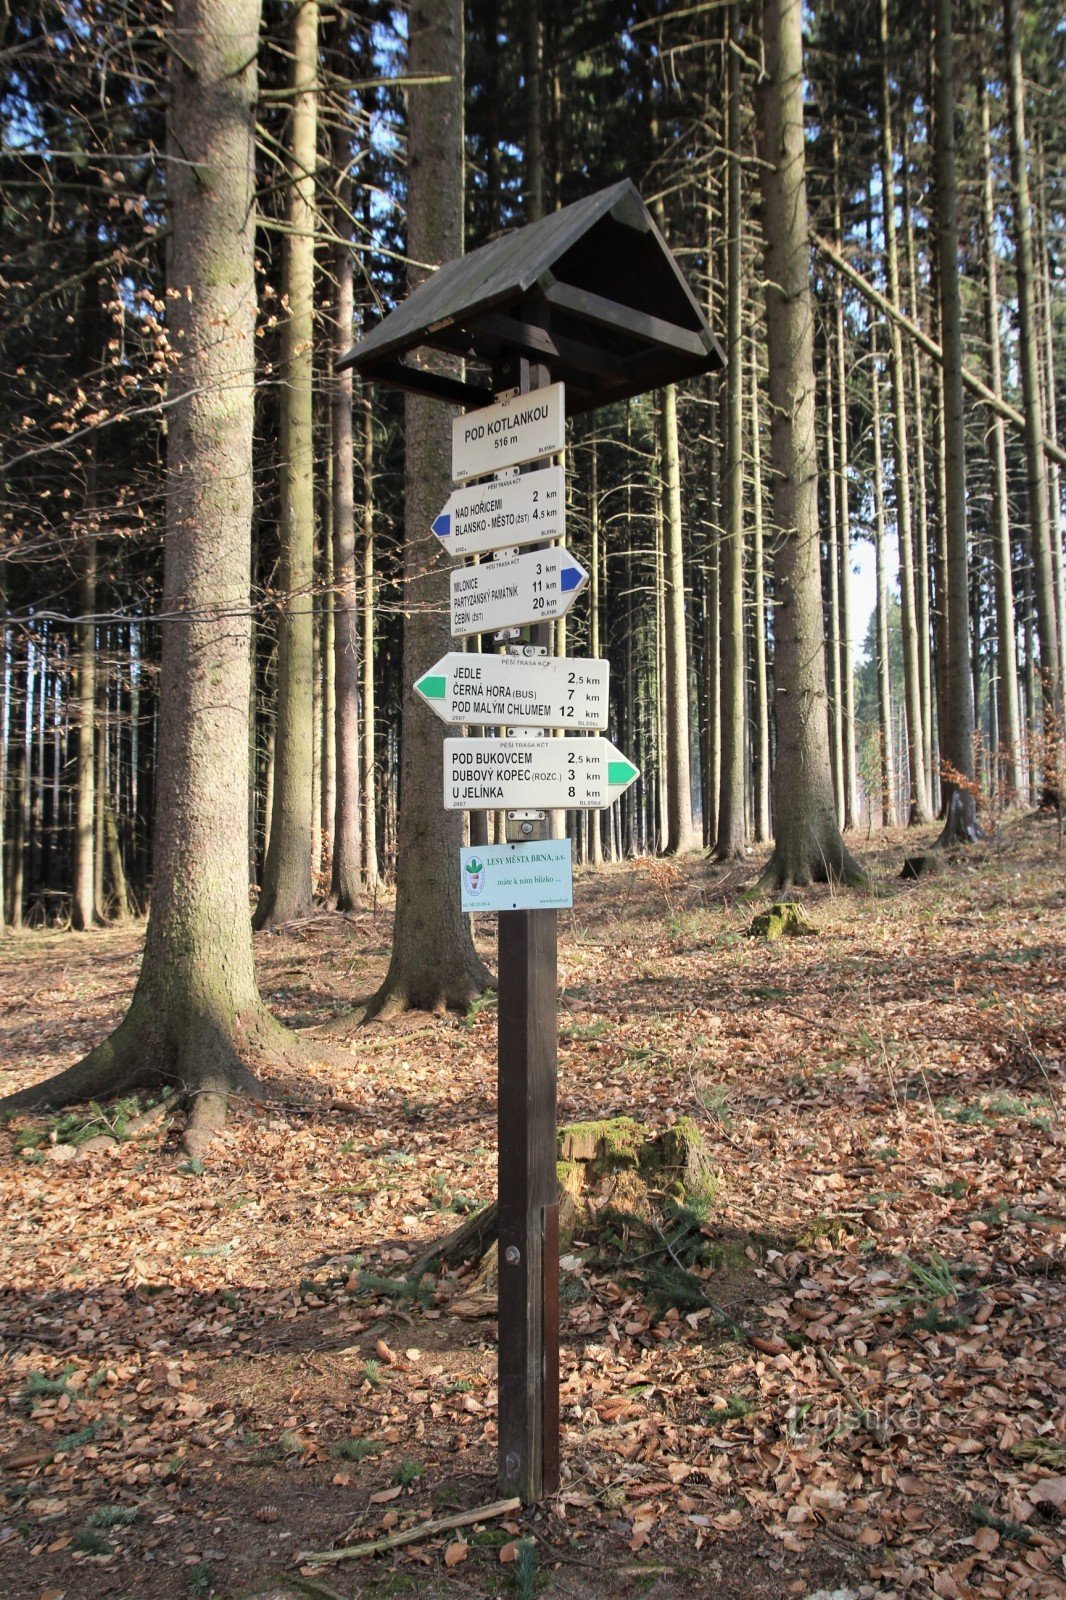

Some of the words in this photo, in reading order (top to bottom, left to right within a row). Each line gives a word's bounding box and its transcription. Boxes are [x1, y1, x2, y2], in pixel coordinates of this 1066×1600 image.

[465, 426, 484, 442] POD
[487, 405, 549, 436] KOTLANKOU
[494, 437, 508, 449] 516
[510, 435, 518, 444] m
[455, 506, 468, 519] NAD
[470, 498, 502, 516] HOŘICEMI
[532, 490, 538, 502] 2
[546, 490, 557, 499] km
[455, 520, 486, 536] BLANSKO
[492, 513, 515, 529] MĚSTO
[532, 508, 544, 520] 4,5
[546, 508, 557, 517] km
[496, 560, 510, 568] TRASA
[454, 578, 478, 593] MILONICE
[536, 564, 542, 575] 3
[546, 563, 556, 572] km
[454, 588, 491, 609] PARTYZÁNSKÝ
[492, 583, 519, 602] PAMÁTNÍK
[532, 580, 542, 592] 11
[546, 580, 557, 590] km
[454, 611, 471, 625] ČEBÍN
[532, 597, 545, 610] 20
[546, 598, 557, 606] km
[453, 668, 482, 679] JEDLE
[568, 673, 584, 685] 2,5
[586, 676, 600, 685] km
[453, 681, 484, 696] ČERNÁ
[486, 686, 511, 697] HORA
[512, 691, 537, 700] (BUS)
[568, 690, 574, 700] 7
[452, 701, 471, 713] POD
[473, 700, 504, 714] MALÝM
[507, 704, 551, 716] CHLUMEM
[559, 706, 574, 717] 12
[452, 753, 473, 764] POD
[476, 753, 532, 764] BUKOVCEM
[567, 753, 583, 764] 2,5
[586, 755, 600, 764] km
[452, 767, 494, 781] DUBOVÝ
[496, 770, 531, 781] KOPEC
[532, 772, 562, 782] (ROZC.)
[568, 770, 575, 781] 3
[452, 787, 459, 798] U
[462, 784, 504, 798] JELÍNKA
[568, 786, 576, 798] 8
[506, 855, 530, 864] MĚSTA
[531, 854, 554, 862] BRNA,
[497, 878, 512, 886] máte
[520, 876, 533, 884] nám
